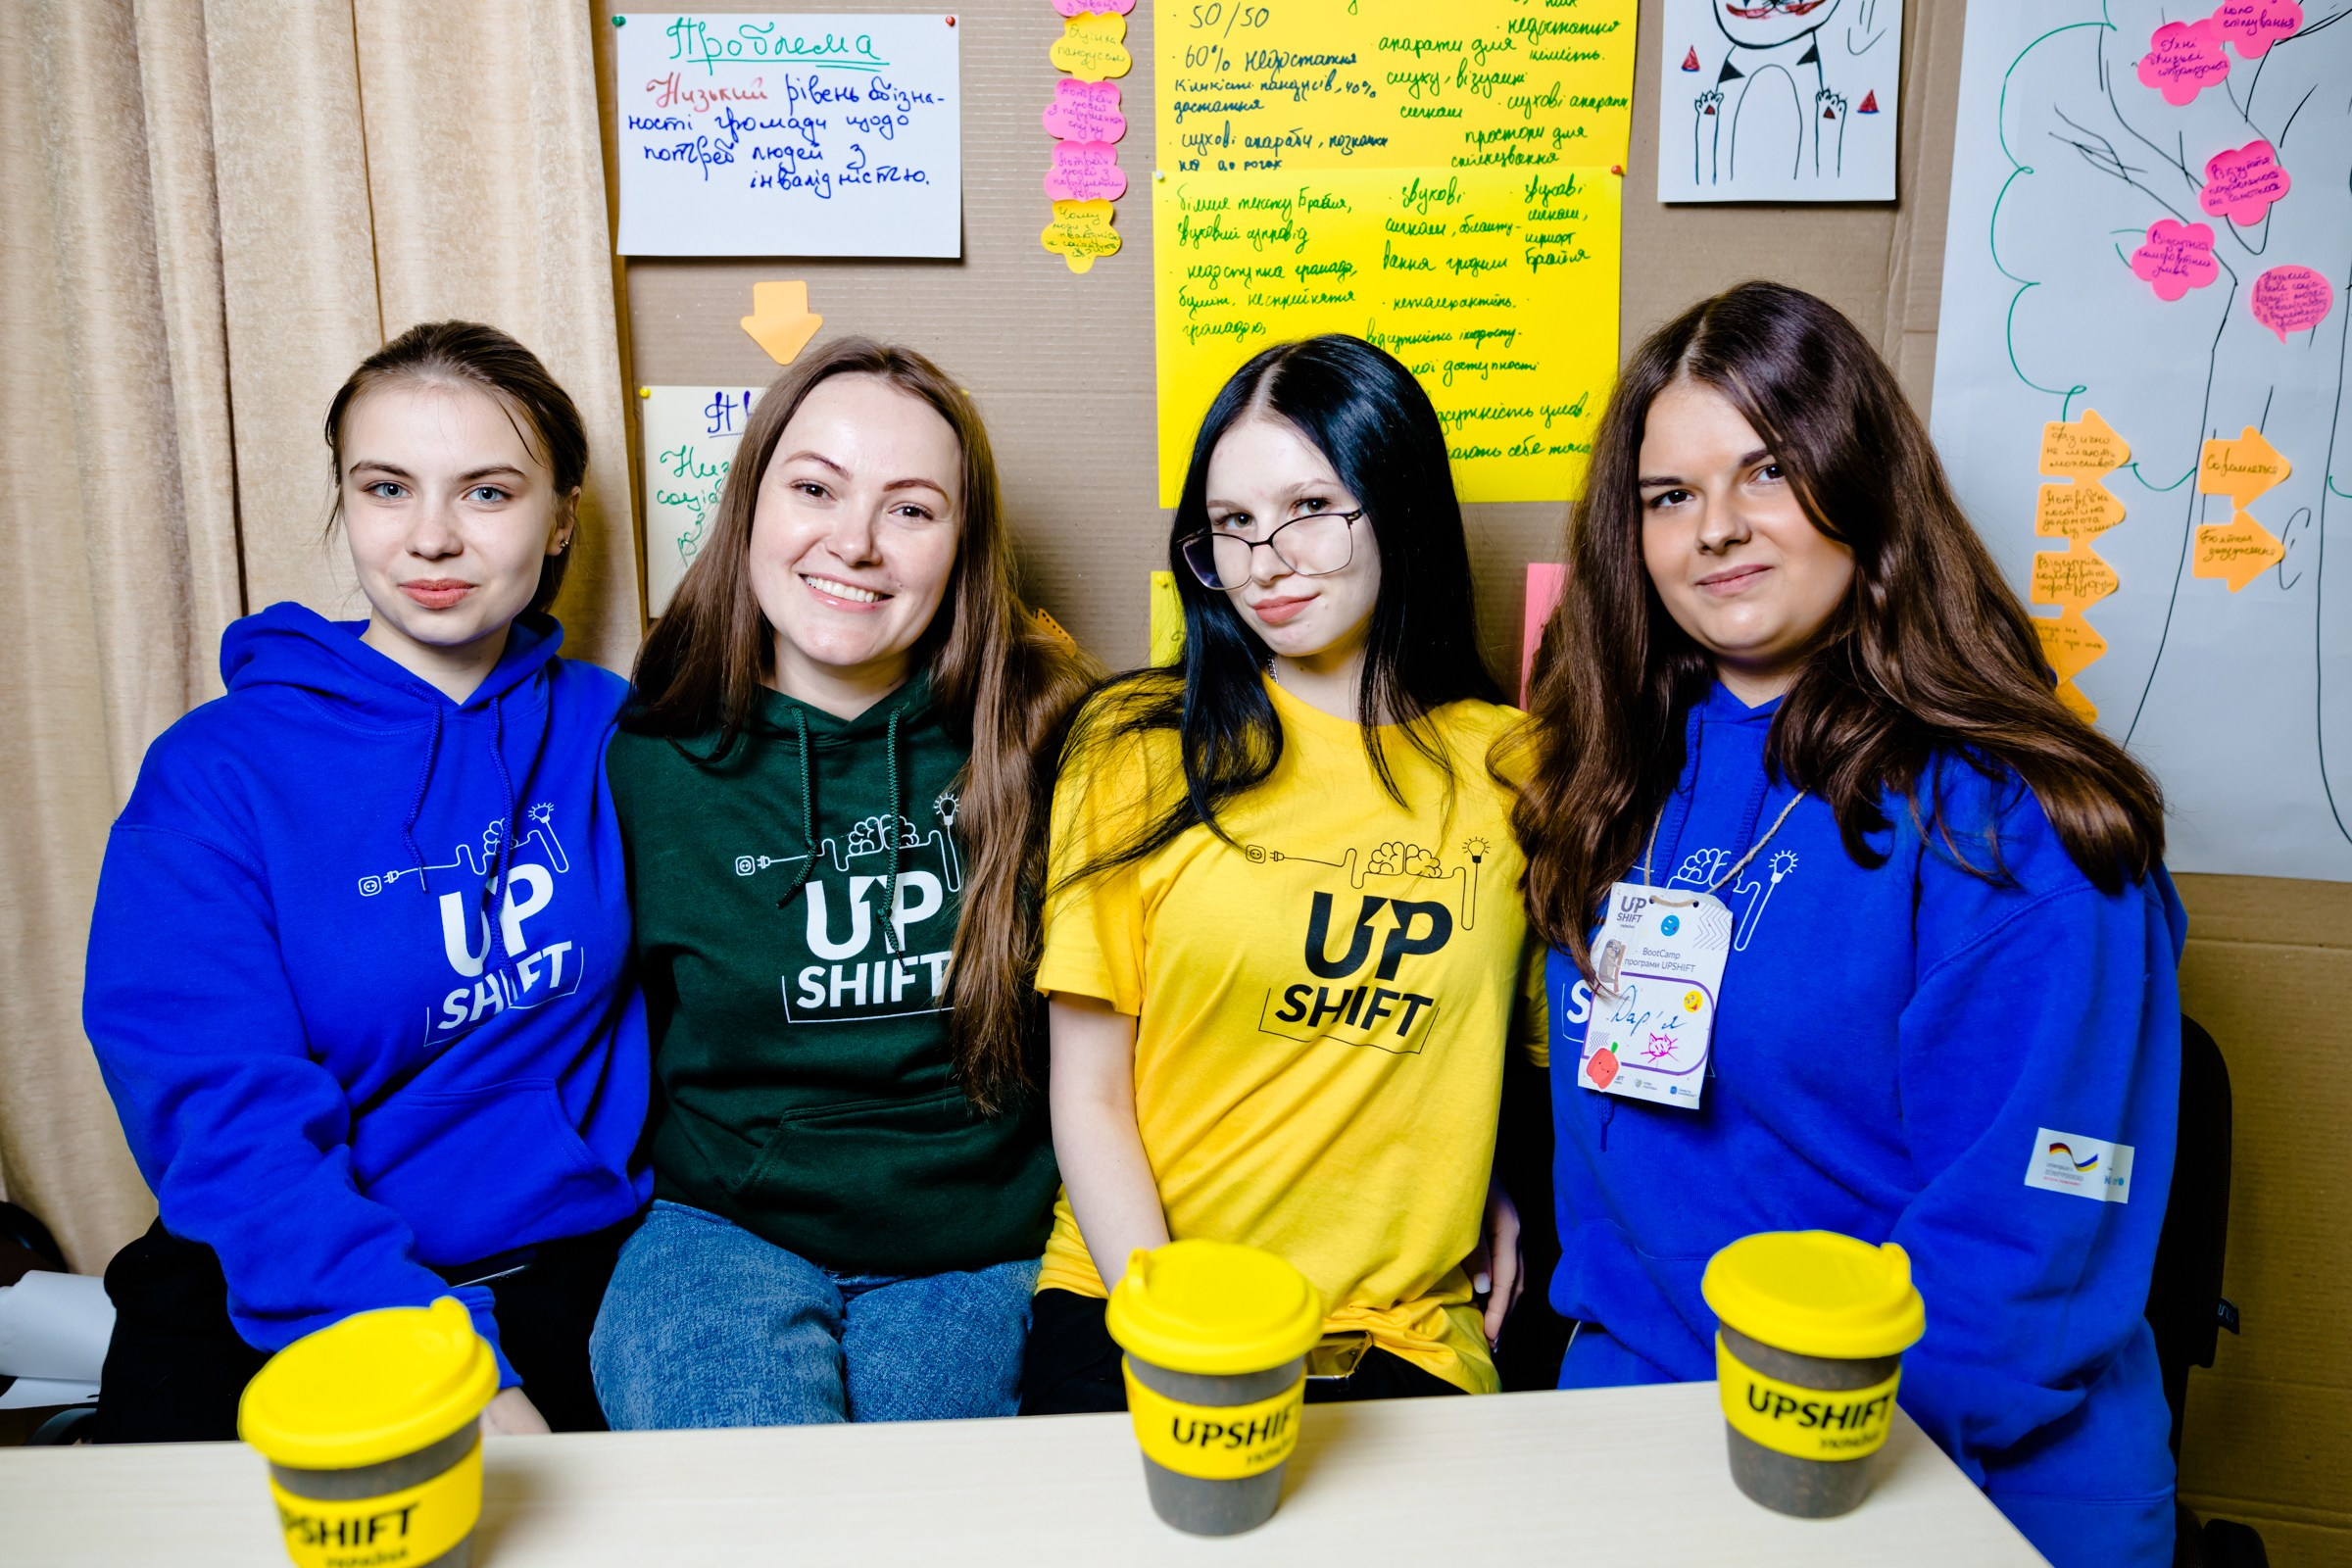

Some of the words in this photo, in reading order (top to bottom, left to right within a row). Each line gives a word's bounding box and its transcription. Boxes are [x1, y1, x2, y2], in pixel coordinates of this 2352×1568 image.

[1189, 2, 1270, 38] 50/50
[666, 17, 882, 75] Проблема
[1185, 44, 1231, 74] 60%
[1379, 36, 1463, 59] апарати
[1471, 37, 1517, 67] для
[646, 72, 768, 113] Низький
[785, 73, 859, 116] рівень
[628, 114, 693, 130] ності
[714, 106, 827, 143] громади
[846, 115, 908, 139] щодо
[1552, 126, 1589, 150] для
[644, 135, 736, 181] потреб
[752, 142, 823, 174] людей
[847, 143, 866, 170] з
[750, 167, 929, 199] інвалідністю.
[1401, 176, 1466, 216] звукові
[438, 863, 555, 978] UP
[806, 870, 943, 961] UP
[1616, 912, 1642, 923] SHIFT
[1620, 895, 1646, 913] UP
[1304, 890, 1453, 982] UP
[1642, 947, 1681, 960] BootCamp
[797, 950, 953, 1009] SHIFT
[1624, 957, 1660, 968] програми
[1661, 961, 1696, 972] UPSHIFT
[437, 940, 572, 1031] SHIFT
[1275, 984, 1435, 1038] SHIFT
[1747, 1383, 1891, 1429] UPSHIFT
[1172, 1408, 1292, 1449] UPSHIF
